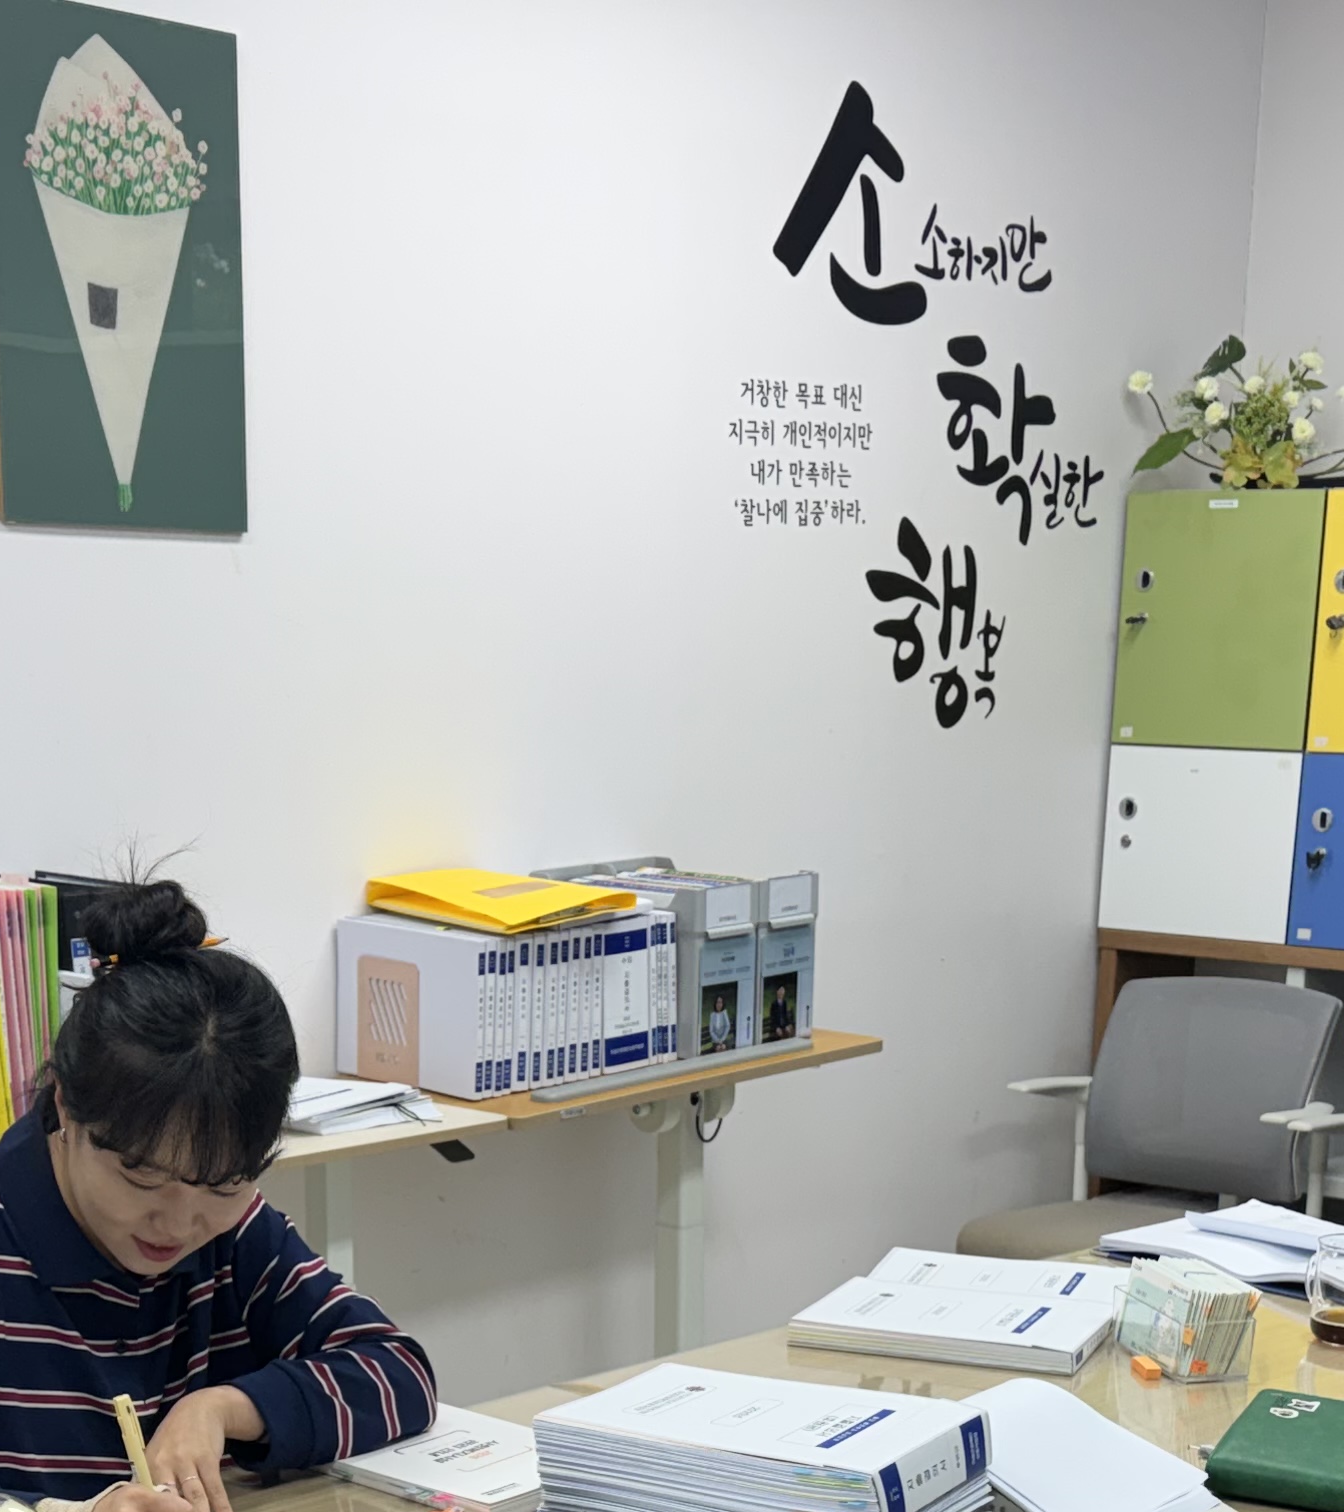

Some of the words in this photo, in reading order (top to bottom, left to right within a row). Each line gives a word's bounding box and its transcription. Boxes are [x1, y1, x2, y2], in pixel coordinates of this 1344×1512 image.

[740, 378, 788, 409] 거창한
[795, 382, 826, 409] 목표
[833, 383, 862, 412] 대신
[728, 418, 774, 447] 지극히
[783, 420, 873, 450] 개인적이지만
[751, 459, 783, 485] 내가
[789, 459, 852, 488] 만족하는
